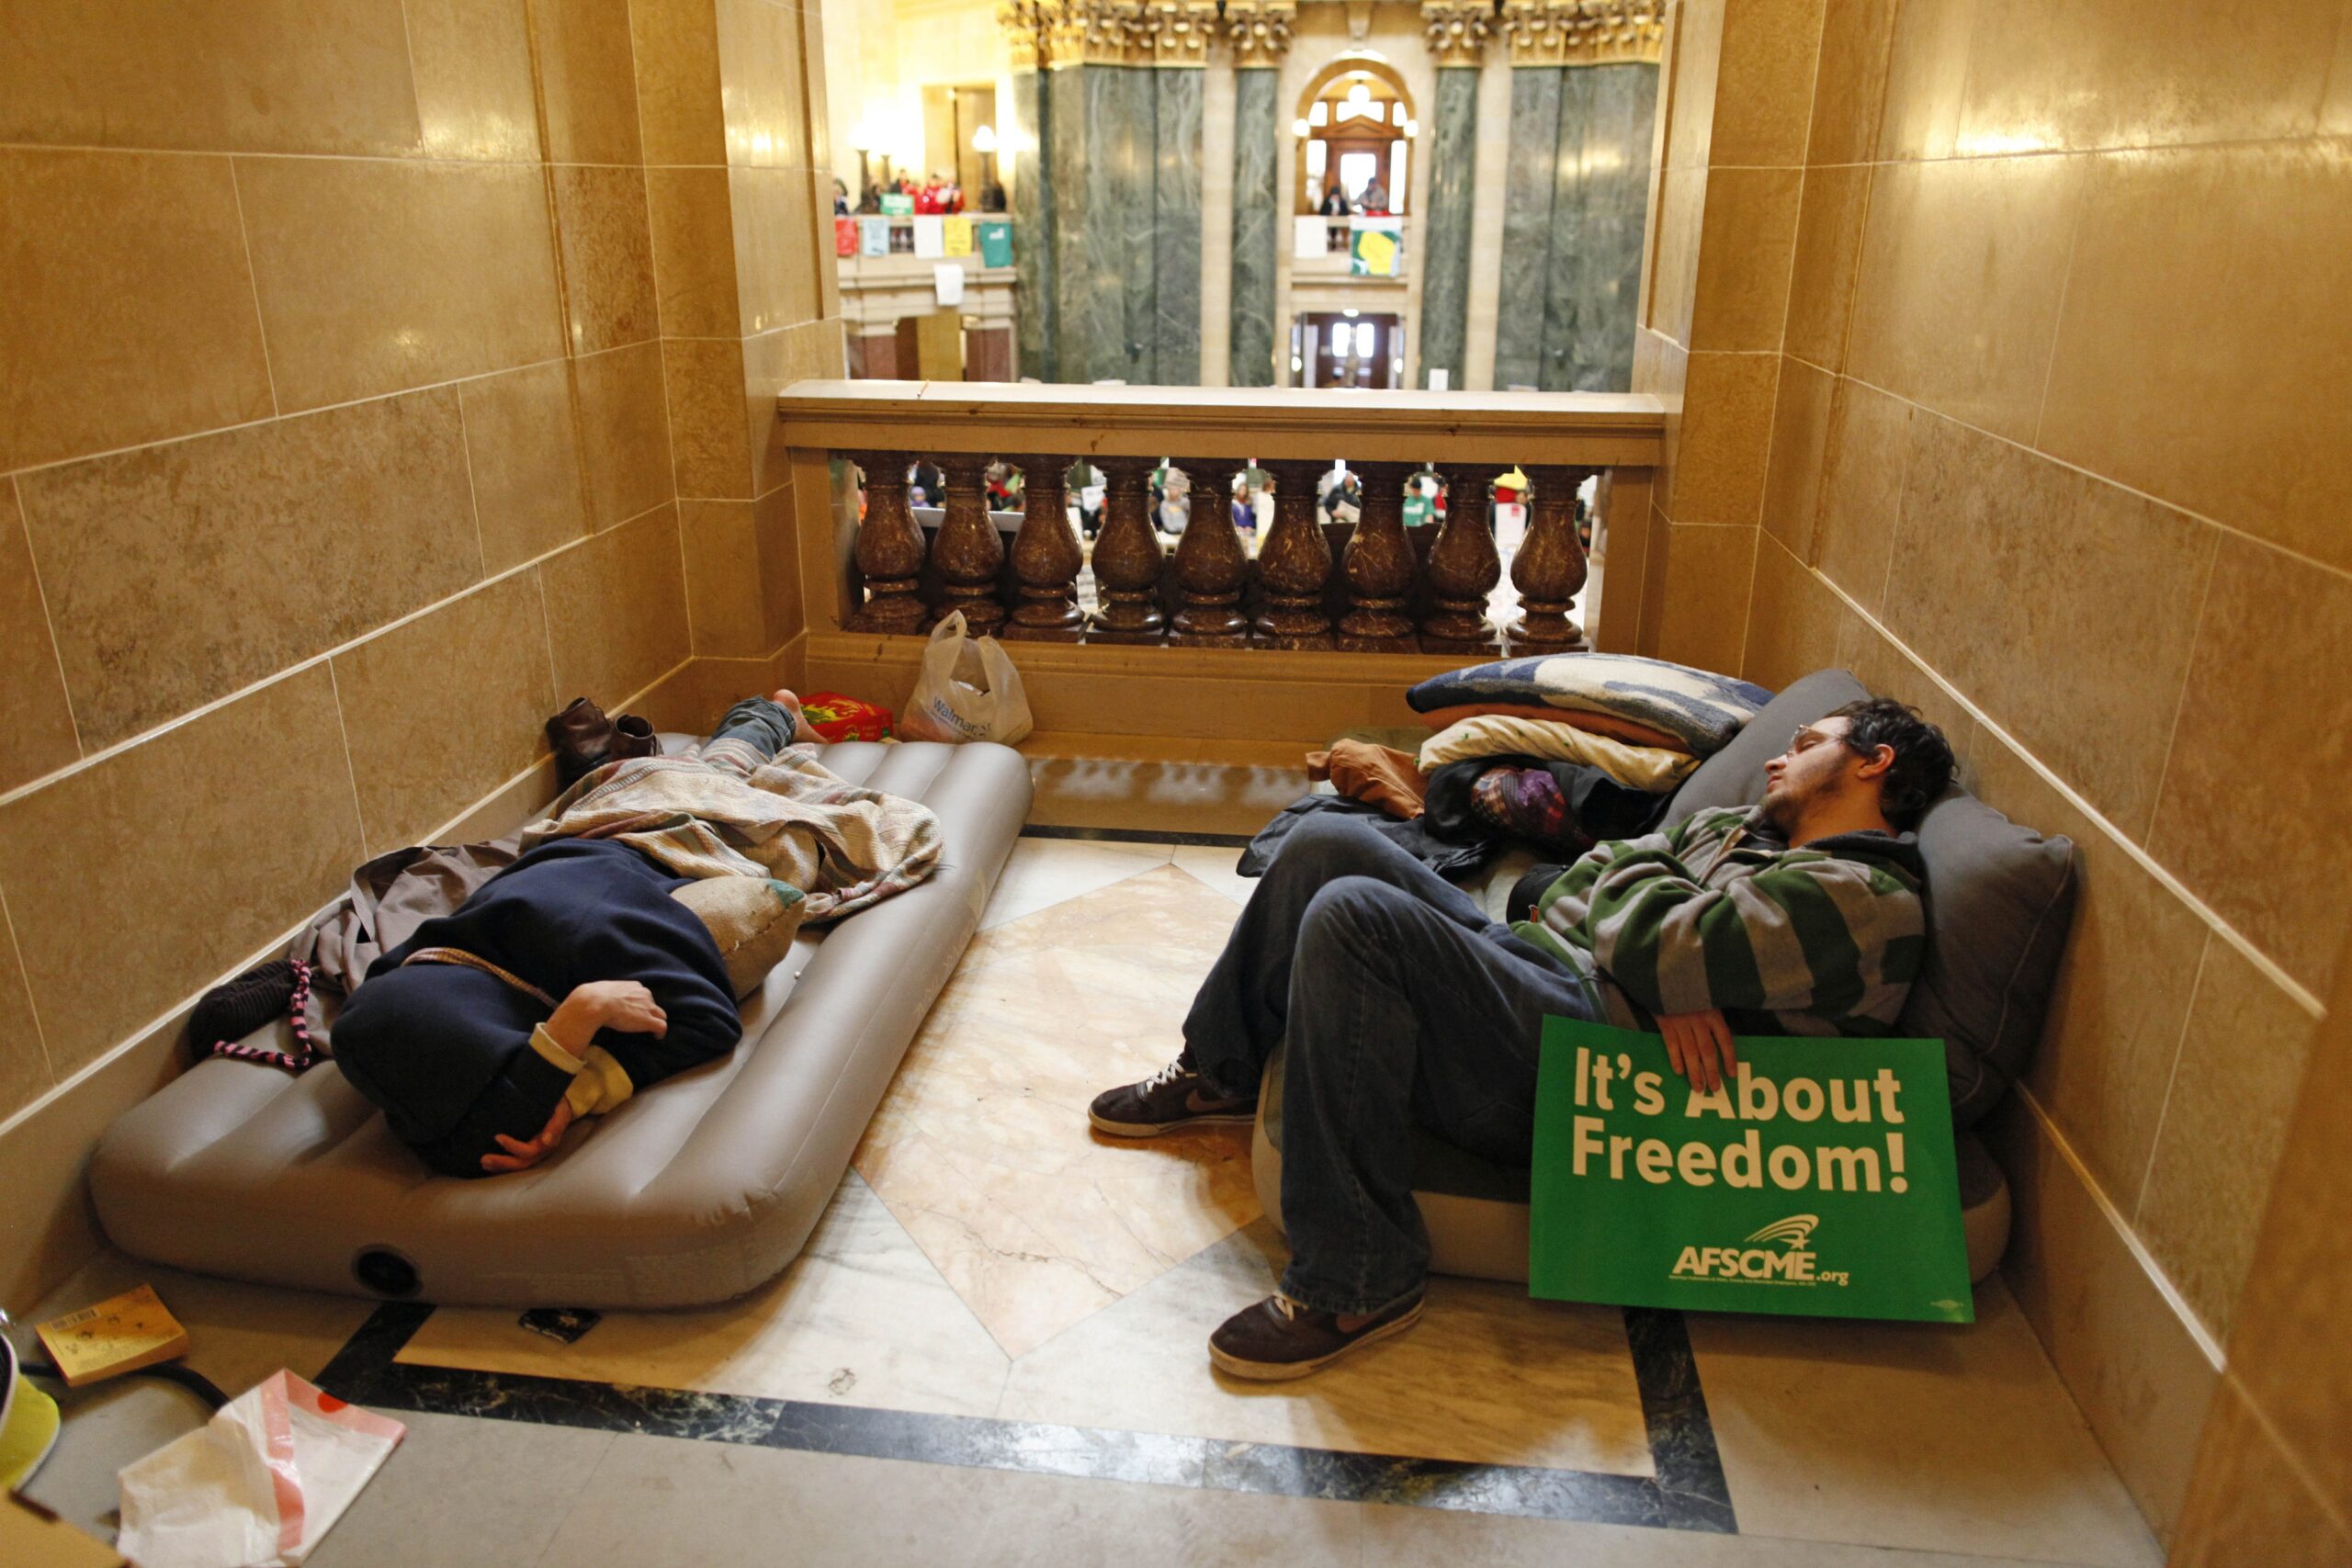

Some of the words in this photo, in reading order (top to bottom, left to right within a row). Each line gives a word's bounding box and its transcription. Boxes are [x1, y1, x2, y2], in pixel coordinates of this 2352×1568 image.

[933, 697, 978, 736] Walmar
[1574, 1046, 1665, 1115] It’s
[1684, 1062, 1905, 1123] About
[1573, 1114, 1908, 1193] Freedom!
